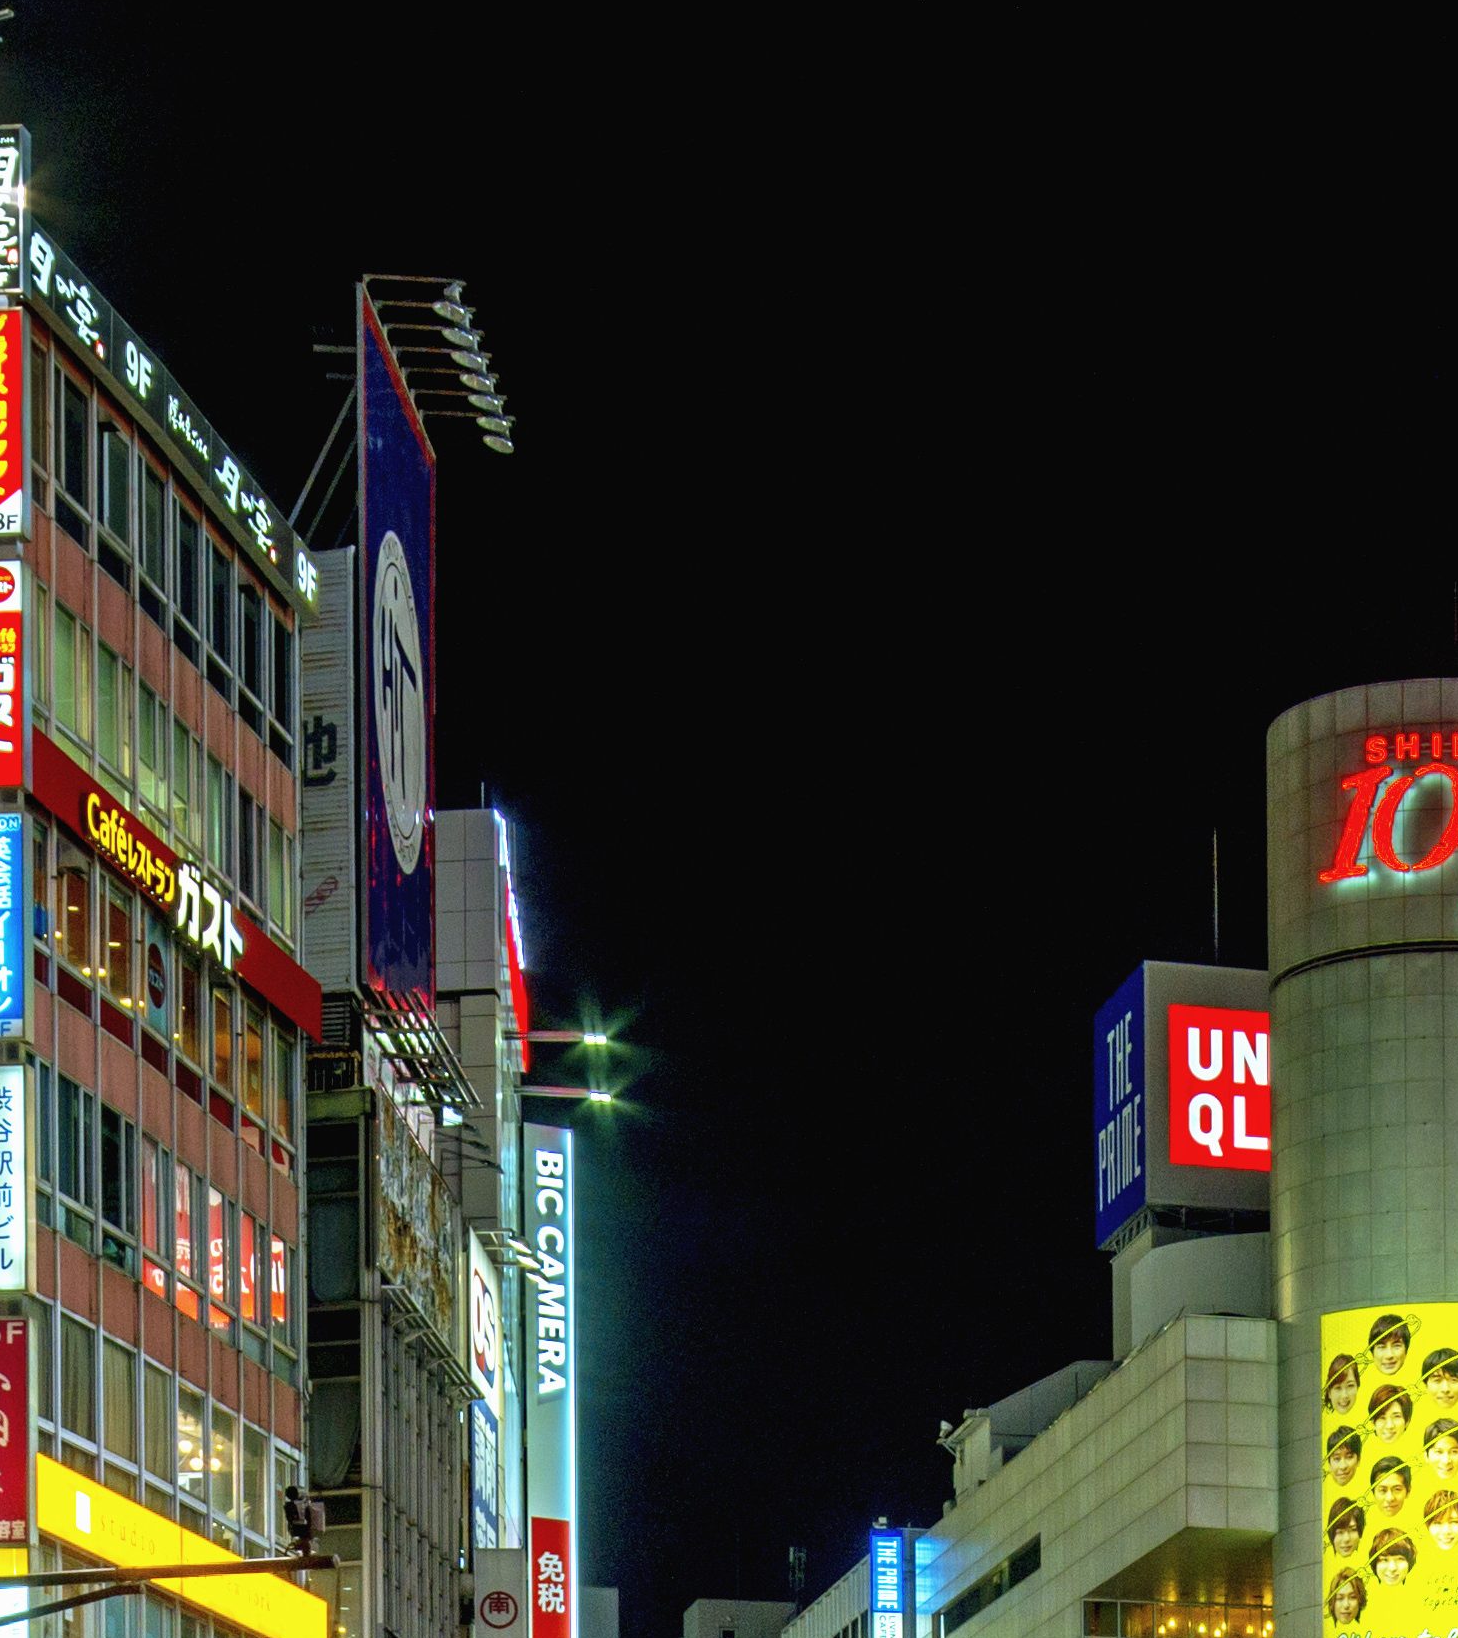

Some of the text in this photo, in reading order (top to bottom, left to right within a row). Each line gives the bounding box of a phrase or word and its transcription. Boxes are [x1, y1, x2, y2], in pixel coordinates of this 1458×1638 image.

[125, 340, 153, 398] 9F
[297, 551, 318, 602] 9F
[177, 863, 244, 971] ガスト
[1106, 1010, 1134, 1113] THE
[1098, 1095, 1142, 1212] PRIME
[535, 1149, 566, 1395] BIC CAMERA
[488, 1592, 510, 1616] 南
[536, 1551, 565, 1614] 免税
[878, 1540, 898, 1610] THE PRIME
